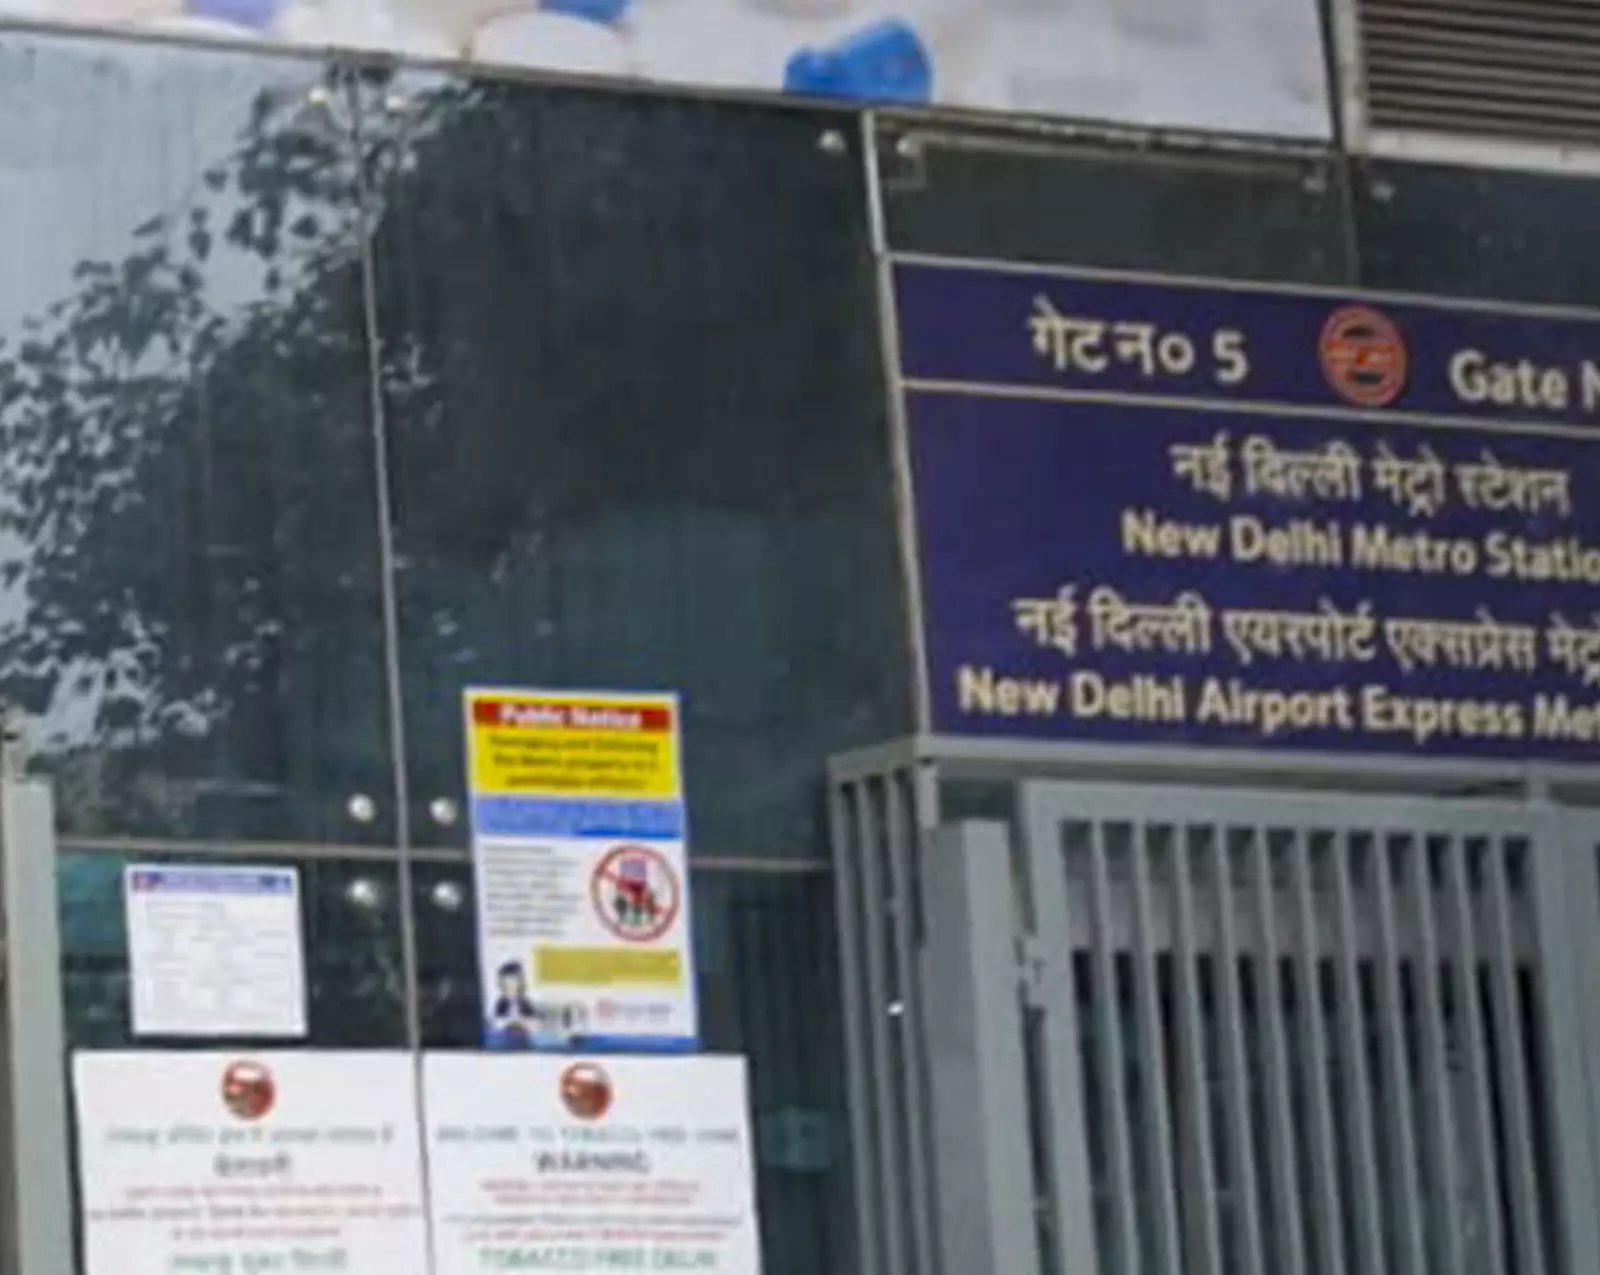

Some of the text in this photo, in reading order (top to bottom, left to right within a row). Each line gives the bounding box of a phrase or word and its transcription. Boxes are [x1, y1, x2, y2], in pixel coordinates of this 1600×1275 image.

[1026, 294, 1107, 372] गेट
[1212, 331, 1249, 383] 5
[1448, 348, 1569, 411] Gate
[1169, 430, 1570, 519] नई दिल्ली मेट्रो स्टेशन
[1121, 509, 1221, 559] New
[1230, 513, 1341, 567] Delhi
[1351, 522, 1478, 575] Metro
[1012, 580, 1078, 658] नई
[1088, 585, 1212, 659] दिल्ली
[1223, 594, 1377, 668] एयरपोर्ट
[1385, 603, 1537, 677] एक्सप्रेस
[958, 664, 1060, 716] New
[1070, 671, 1185, 724] Delhi
[1198, 676, 1352, 731] Airport
[1362, 685, 1523, 745] Express
